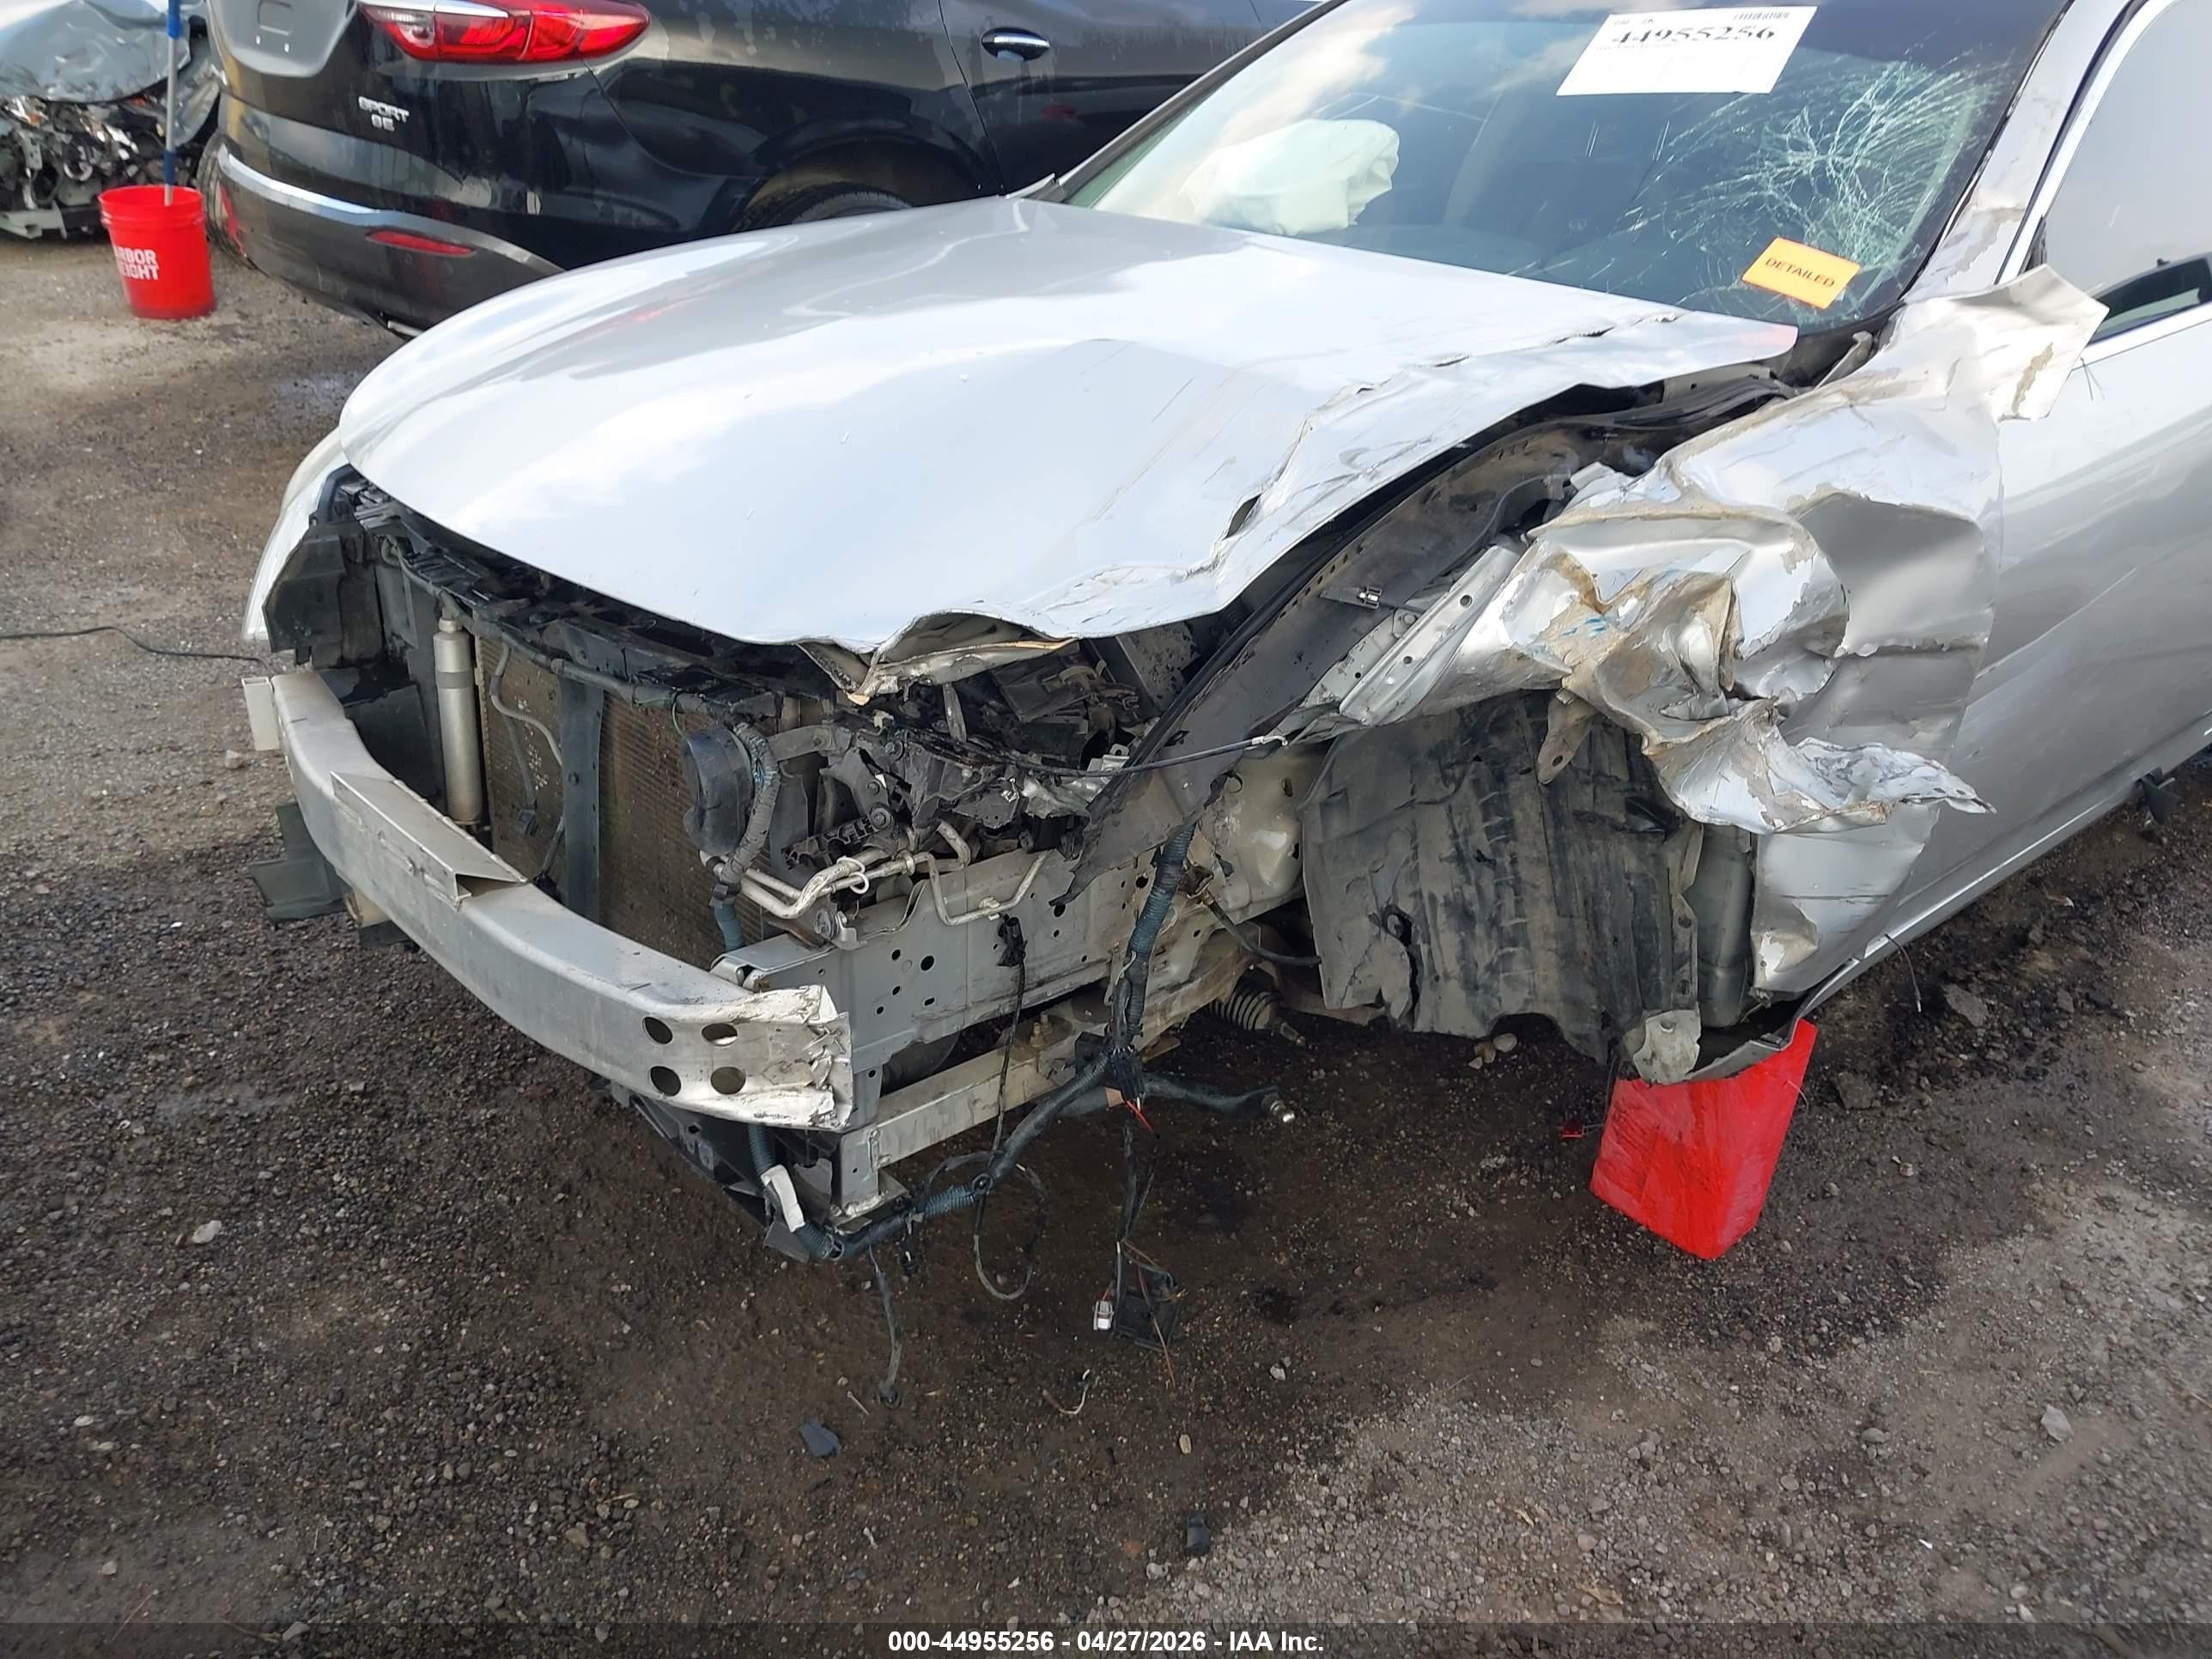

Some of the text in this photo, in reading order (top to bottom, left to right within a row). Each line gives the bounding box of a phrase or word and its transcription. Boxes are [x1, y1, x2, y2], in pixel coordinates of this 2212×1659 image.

[1612, 26, 1776, 44] 44955256
[358, 95, 410, 123] SPORT
[1765, 257, 1836, 288] DETAILED
